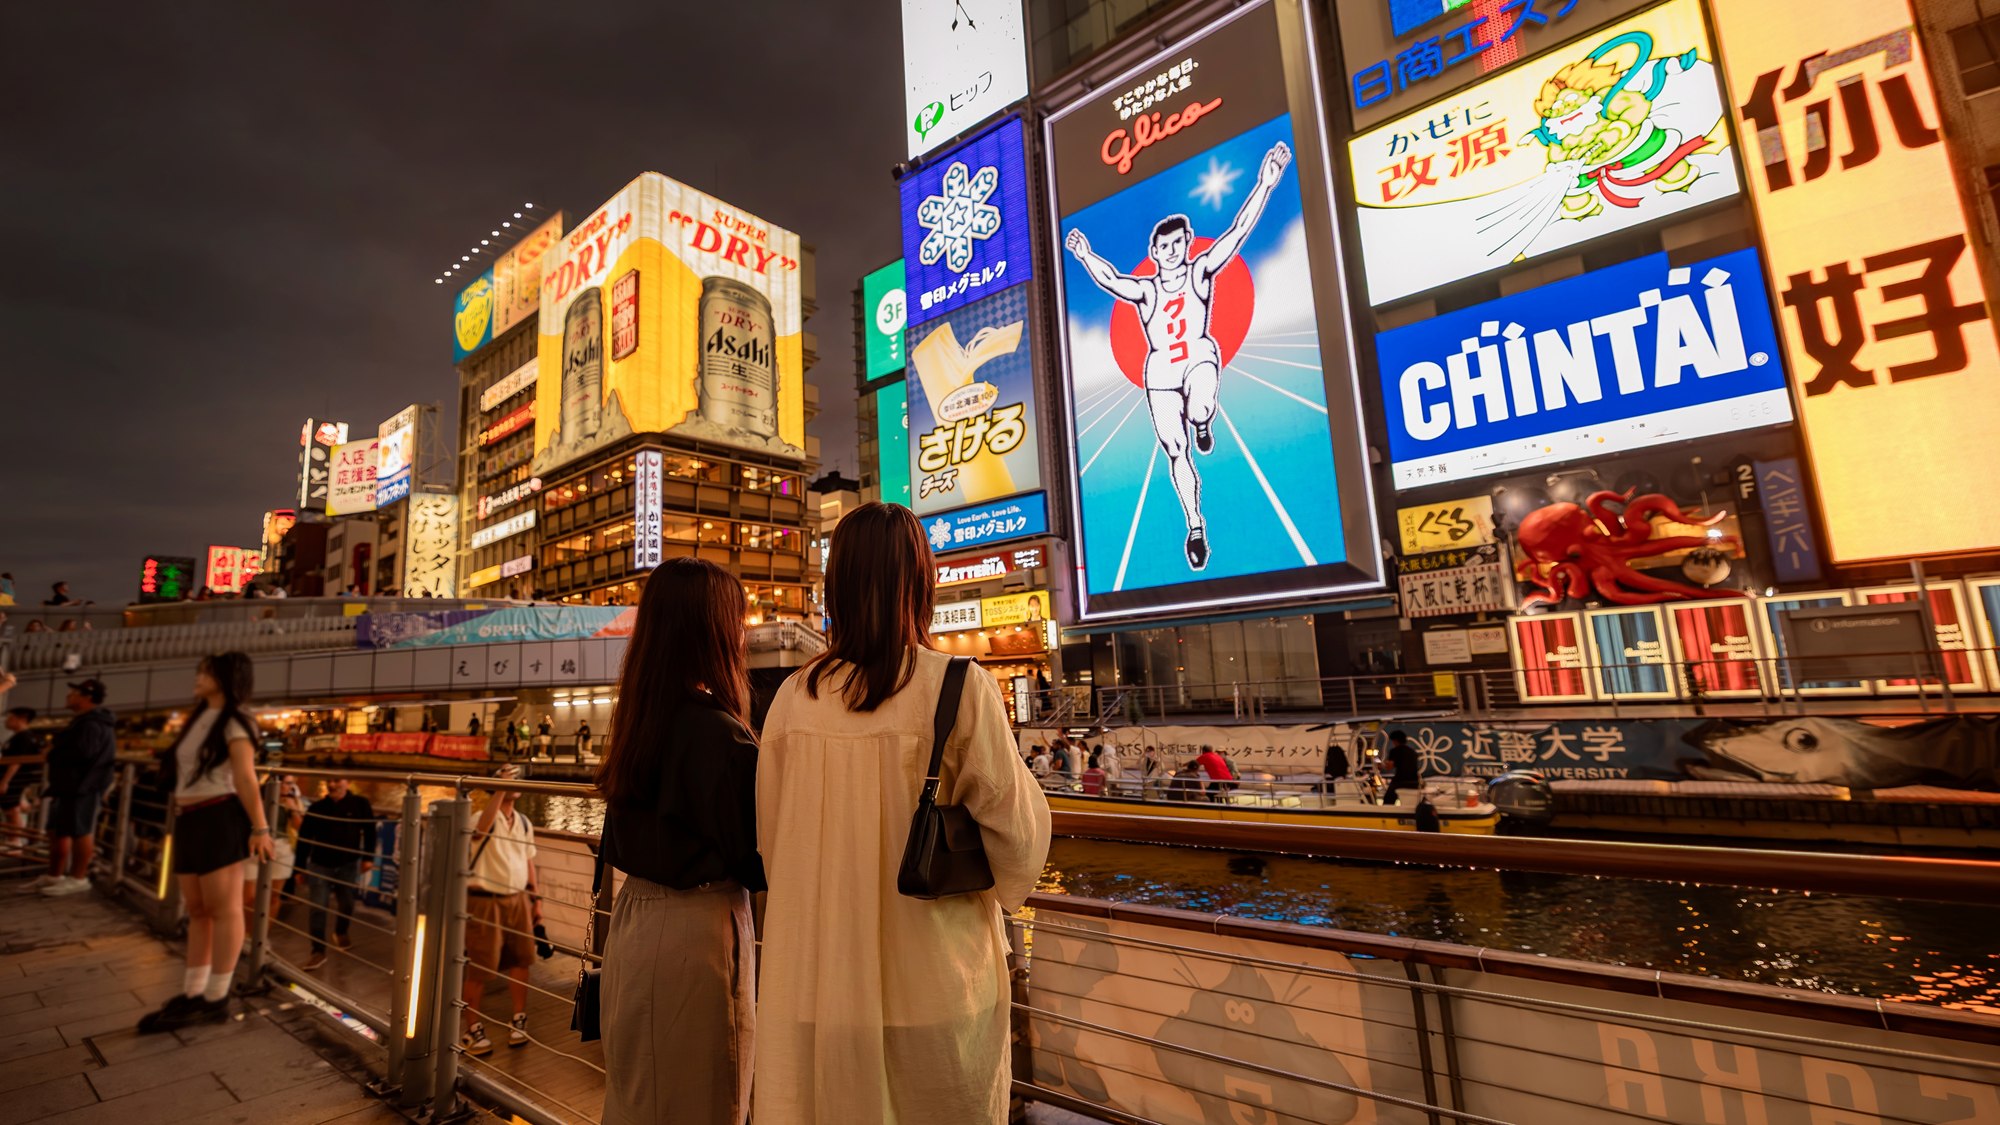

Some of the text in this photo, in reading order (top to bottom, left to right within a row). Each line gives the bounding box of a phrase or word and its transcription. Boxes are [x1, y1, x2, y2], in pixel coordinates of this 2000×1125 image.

[1101, 97, 1222, 174] Glico
[1388, 101, 1493, 157] かぜに
[1377, 118, 1511, 203] 改源
[714, 210, 766, 242] SUPER
[1740, 25, 1990, 398] 你好
[883, 302, 903, 325] 3F
[1163, 292, 1189, 364] グリコ
[707, 326, 769, 368] Asahi
[1399, 267, 1748, 442] CHINTAI
[731, 363, 748, 378] 生
[919, 402, 1025, 473] さける
[920, 468, 958, 499] チーズ
[1736, 464, 1755, 499] 2F
[1418, 508, 1473, 541] くくる
[457, 659, 576, 676] えびす橋
[1461, 726, 1627, 764] 近畿大学
[1532, 767, 1629, 779] NIVERSITY
